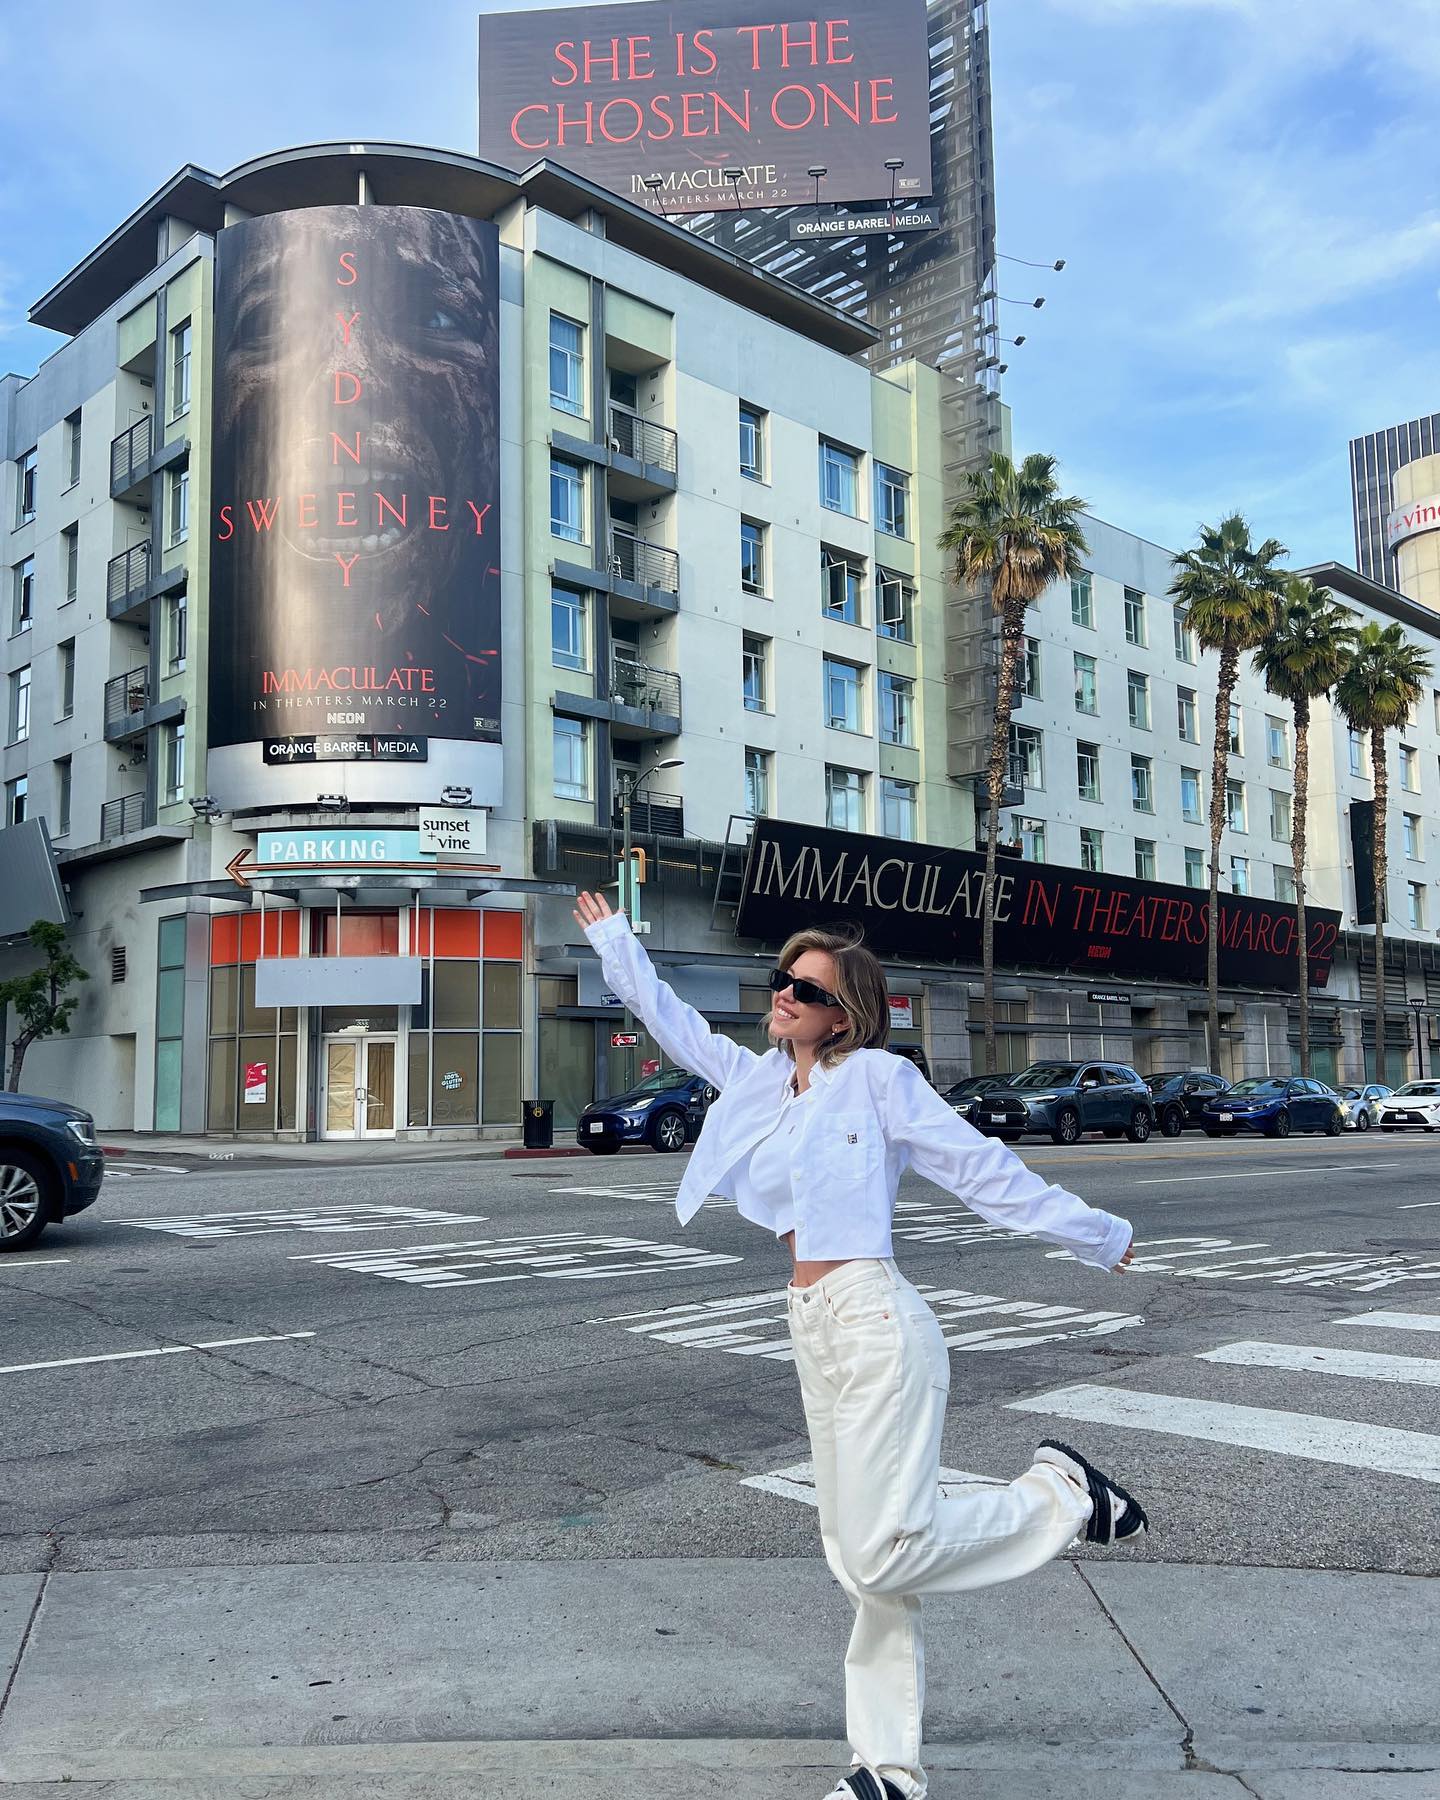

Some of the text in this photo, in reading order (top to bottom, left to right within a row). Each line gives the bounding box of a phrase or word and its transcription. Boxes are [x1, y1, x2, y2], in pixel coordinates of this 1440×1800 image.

[551, 19, 855, 88] SHE IS THE
[510, 77, 899, 150] CHOSEN ONE
[643, 193, 710, 207] THEATERS
[717, 190, 764, 203] MARCH
[771, 188, 788, 199] 22
[796, 214, 932, 235] ORANGE BARREL MEDIA
[217, 492, 492, 541] SWEENEY
[262, 666, 436, 694] IMMACULATE
[253, 695, 448, 711] IN THEATERS MARCH 22
[326, 712, 366, 725] NEON
[269, 741, 419, 756] ORANGE BARREL MEDIA
[422, 818, 471, 833] sunset
[270, 839, 386, 861] PARKING
[437, 835, 471, 850] vine
[752, 839, 1338, 960] IMMACULATE IN THEATERS MARCH 22
